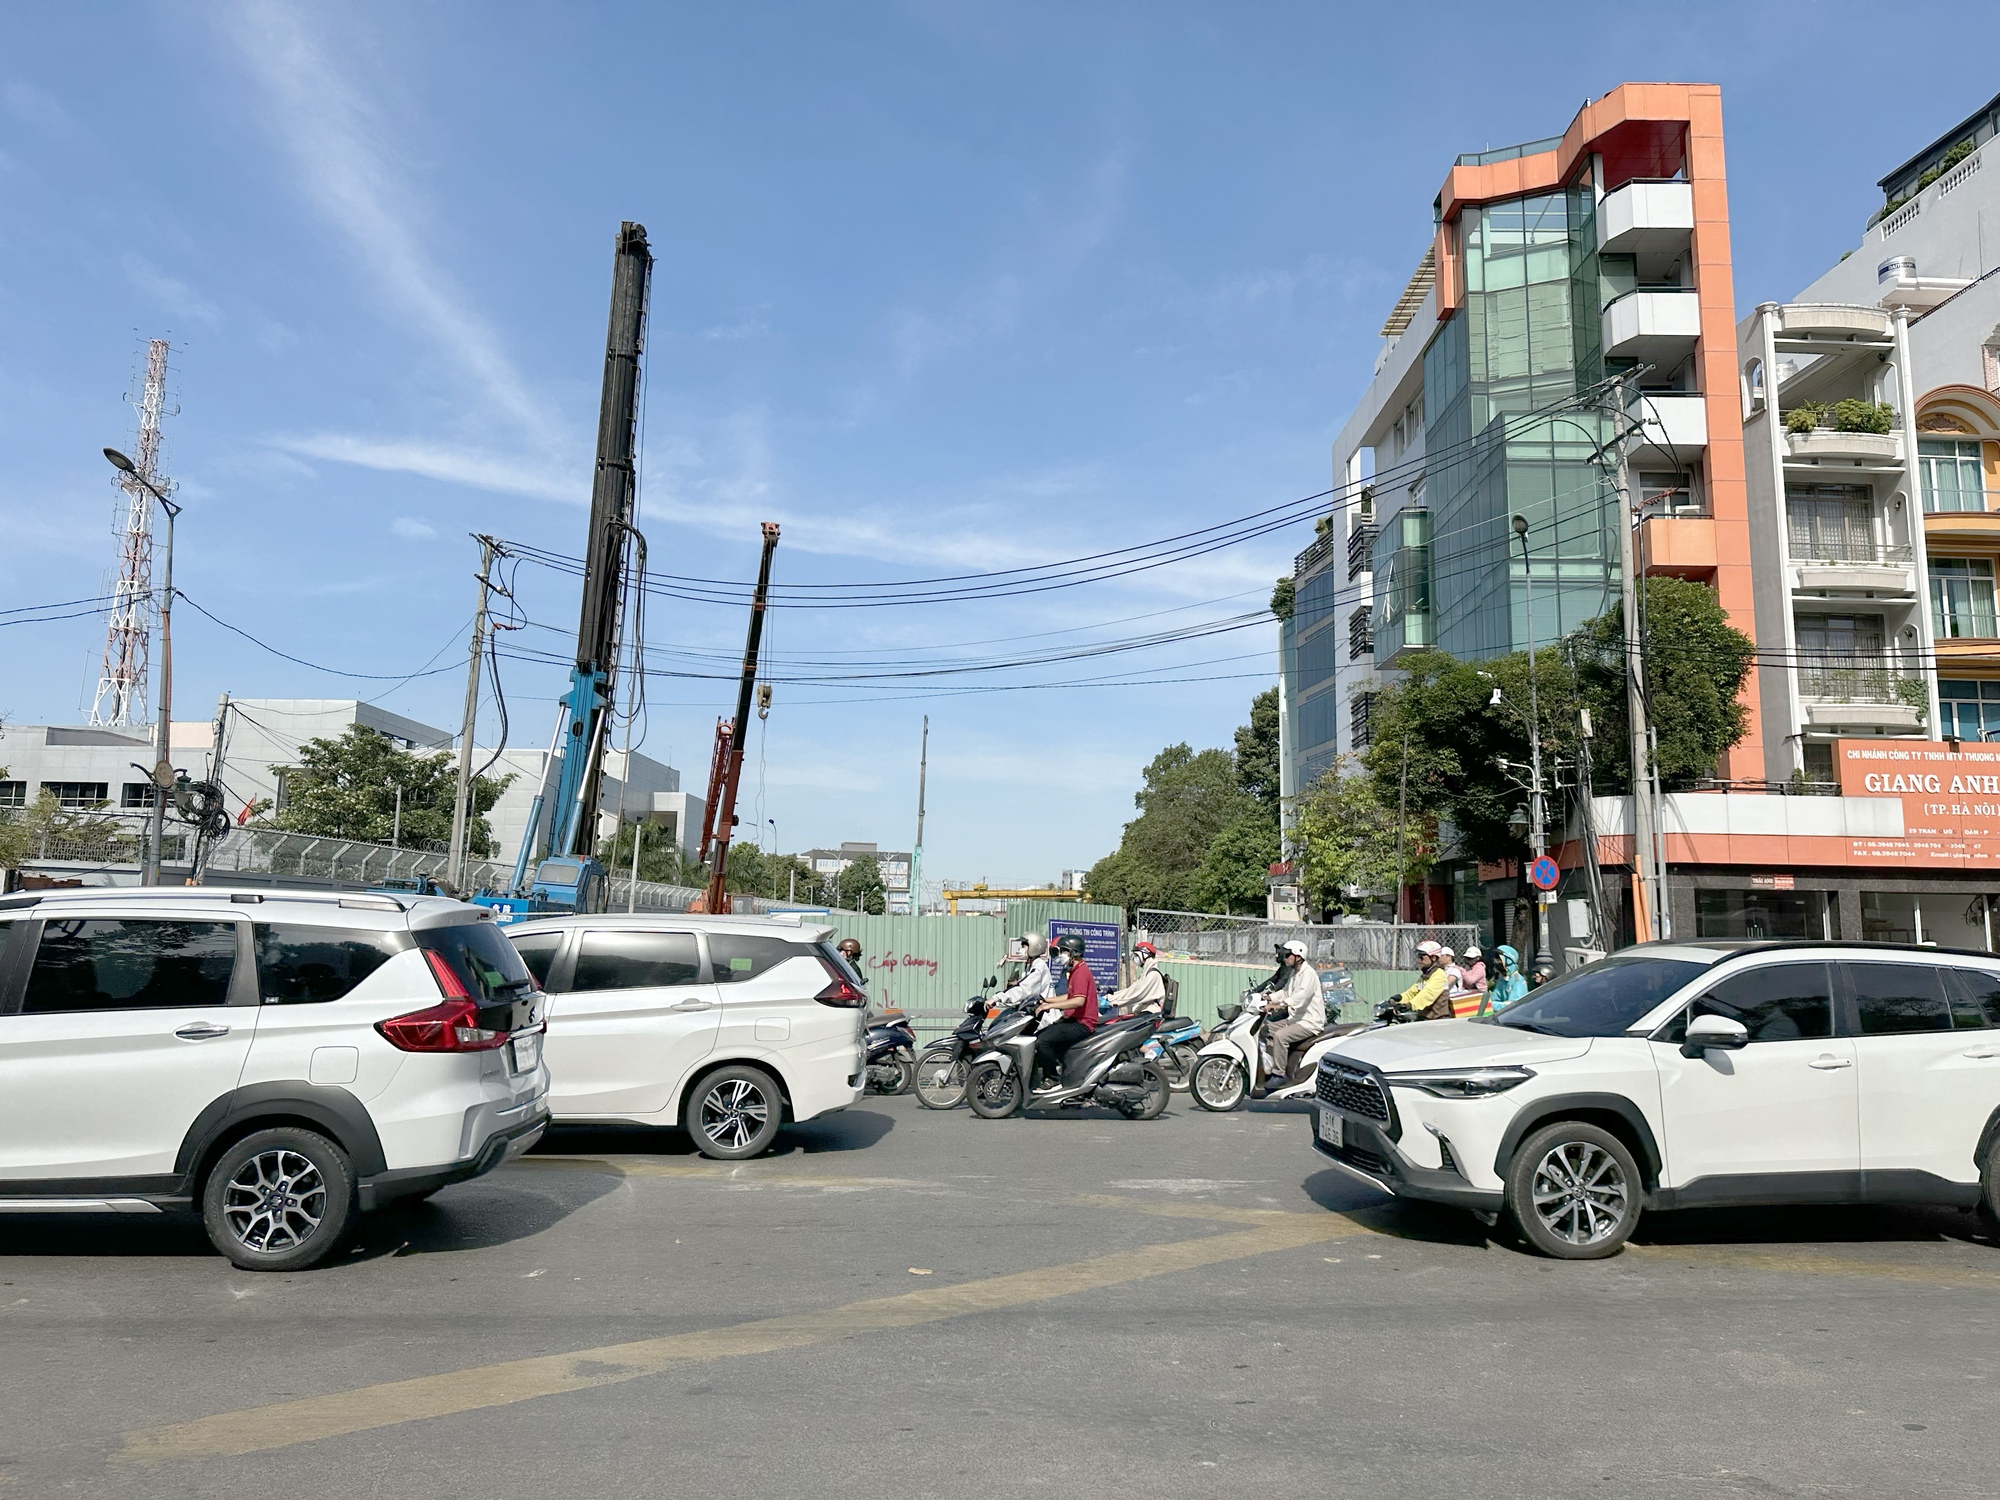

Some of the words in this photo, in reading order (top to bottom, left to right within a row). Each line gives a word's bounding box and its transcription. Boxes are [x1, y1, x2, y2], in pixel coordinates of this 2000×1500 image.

[1847, 750, 1860, 759] CHI
[1911, 751, 1921, 760] TY
[1924, 751, 1945, 761] TNHH
[1864, 773, 1941, 793] GIANG
[1949, 775, 2000, 794] ANH
